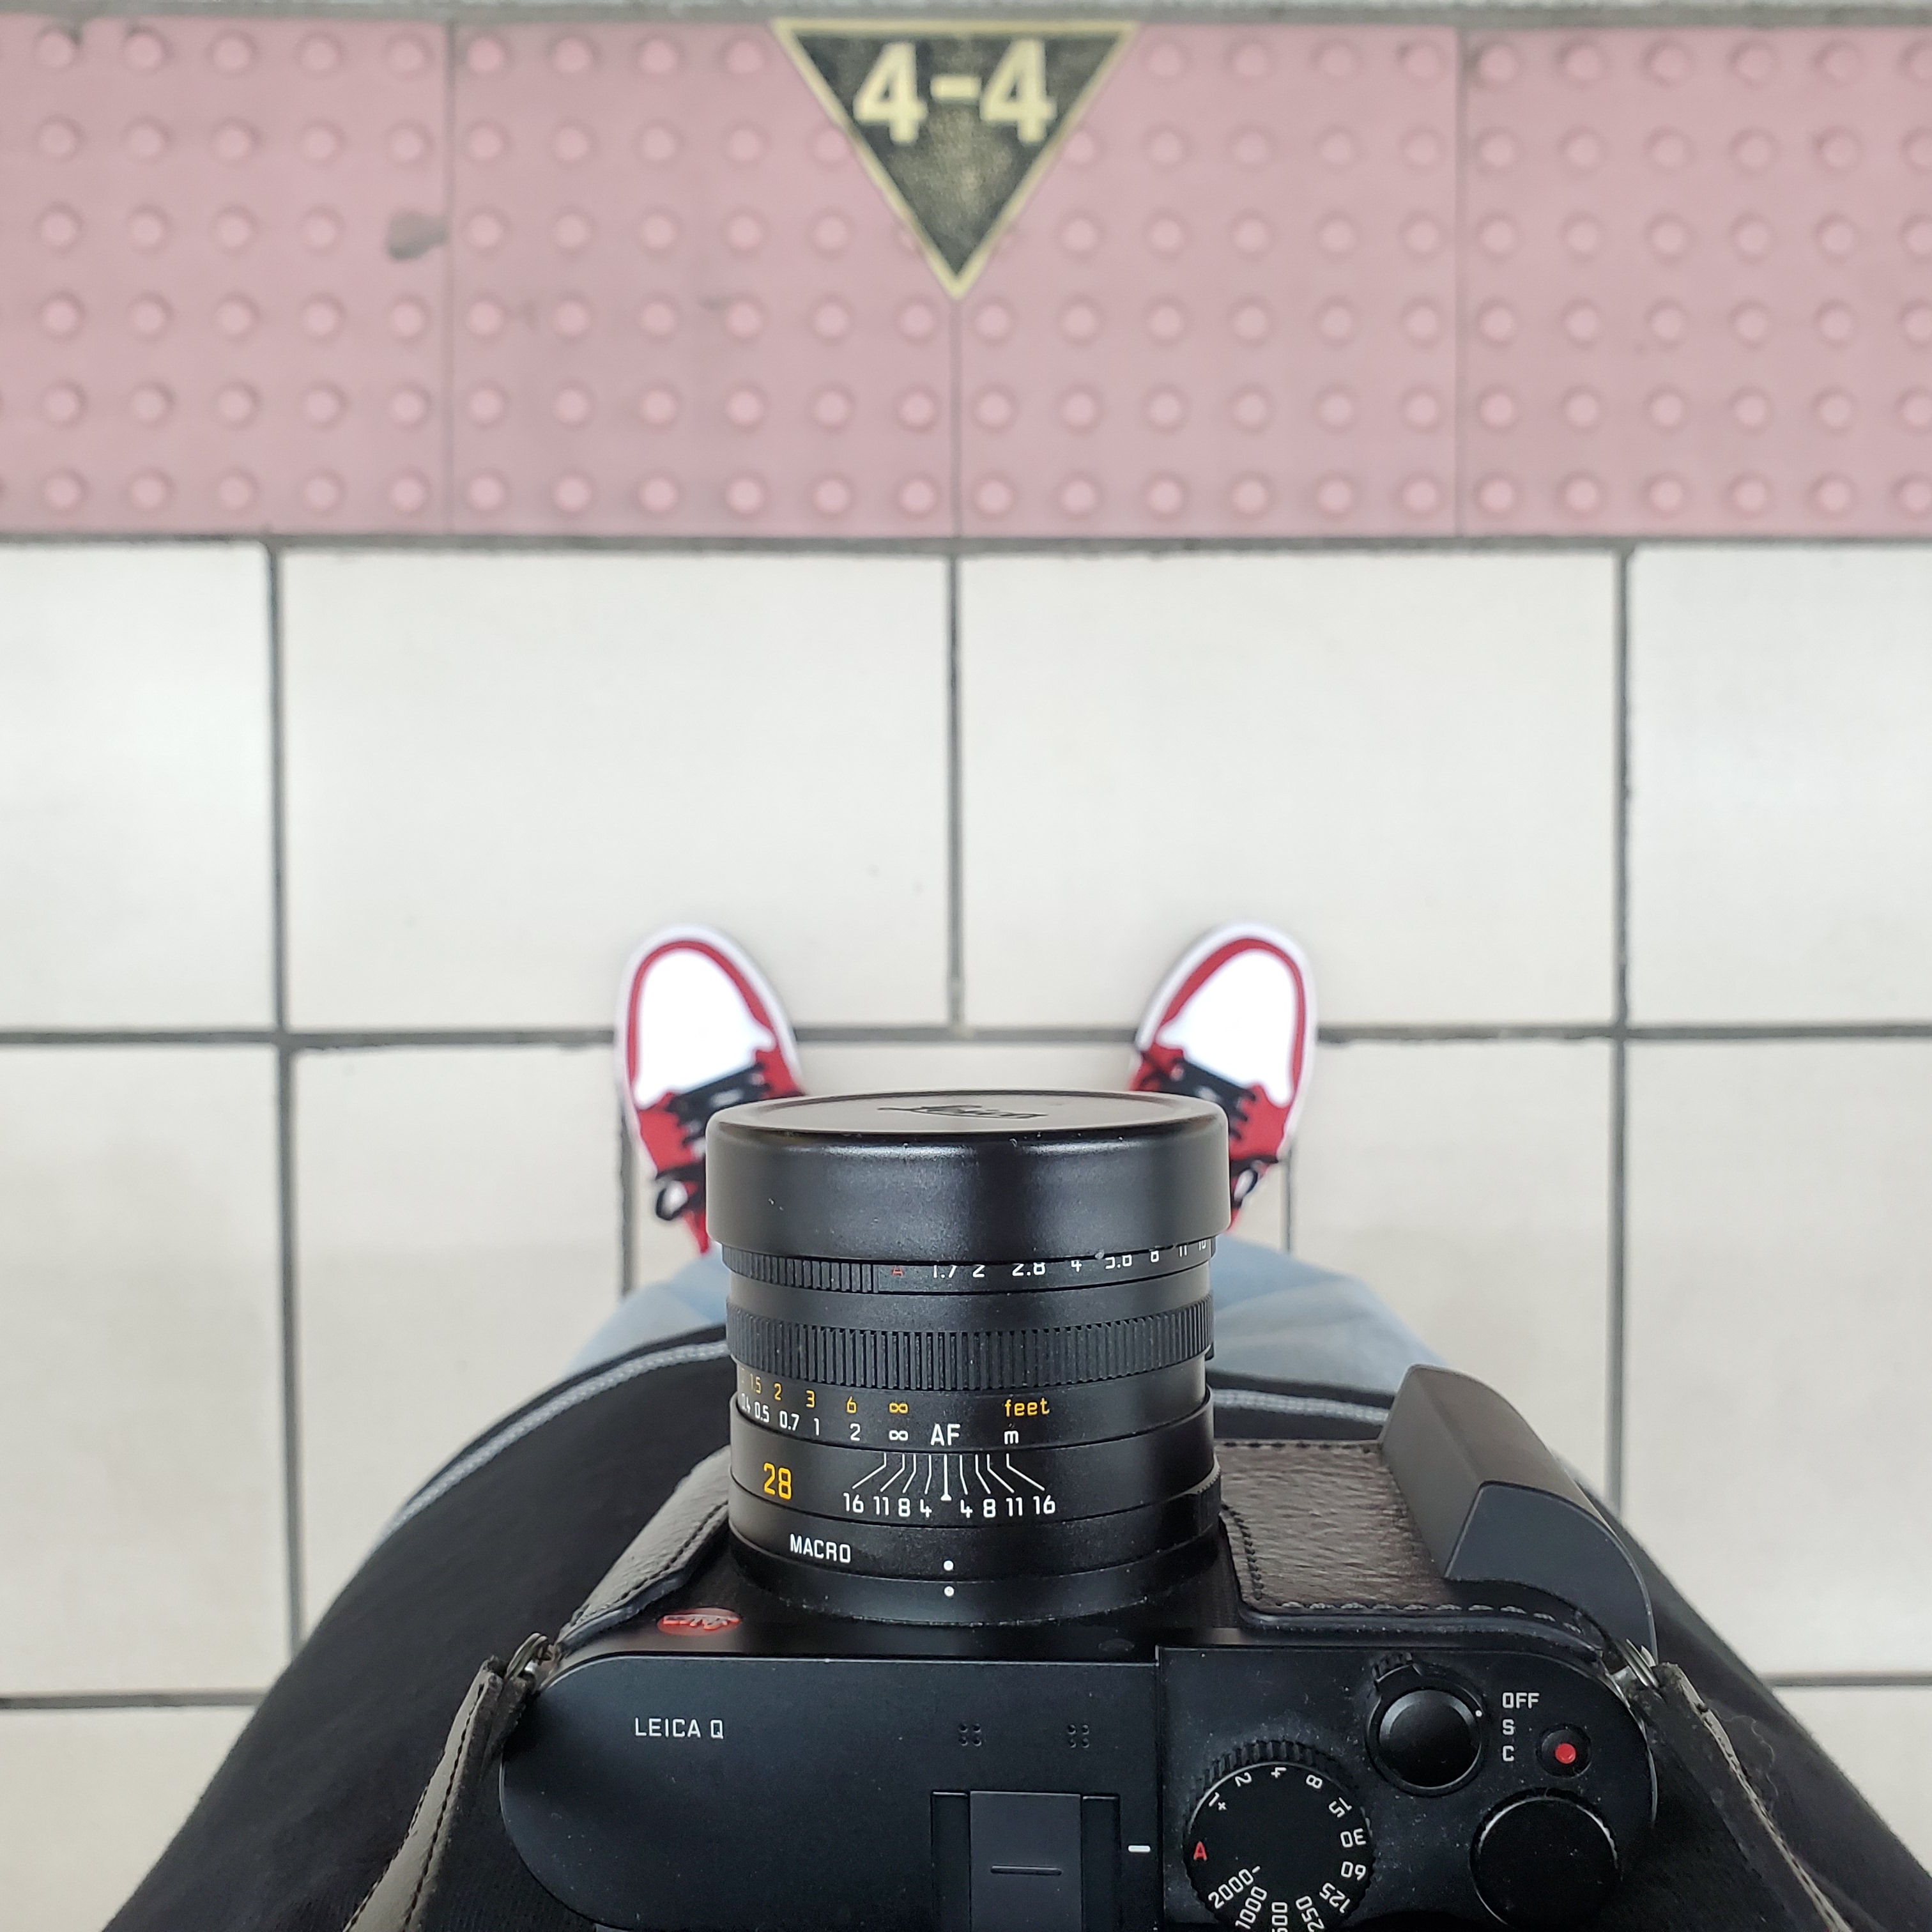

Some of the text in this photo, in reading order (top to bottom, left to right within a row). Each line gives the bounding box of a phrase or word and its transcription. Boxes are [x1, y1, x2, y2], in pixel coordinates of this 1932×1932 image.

[853, 40, 1057, 145] 4-4
[972, 1264, 986, 1278] 2
[1012, 1262, 1045, 1276] 2.8
[1071, 1260, 1082, 1272] 4
[774, 1383, 782, 1401] 2
[806, 1390, 815, 1408] 3
[846, 1395, 857, 1414] 6
[1004, 1397, 1050, 1417] feet
[755, 1401, 770, 1423] 0.5
[779, 1410, 800, 1431] 0.7
[813, 1418, 820, 1436] 1
[850, 1423, 861, 1441] 2
[930, 1423, 960, 1446] AF
[1004, 1430, 1019, 1445] m
[763, 1462, 792, 1500] 28
[843, 1492, 1055, 1518] 16 11 8 4 4 8 11 16
[790, 1533, 851, 1563] MACRO
[1502, 1692, 1540, 1709] OFF
[635, 1717, 724, 1739] LEICA Q
[1502, 1719, 1515, 1735] S
[1502, 1745, 1515, 1761] C
[1234, 1772, 1252, 1787] 2
[1271, 1767, 1287, 1778] 4
[1306, 1774, 1323, 1790] 8
[1328, 1797, 1353, 1818] 15
[1340, 1828, 1367, 1848] 30
[1193, 1841, 1208, 1861] A
[1341, 1861, 1367, 1881] 60
[1235, 1886, 1268, 1929] 1000
[1319, 1882, 1351, 1913] 125
